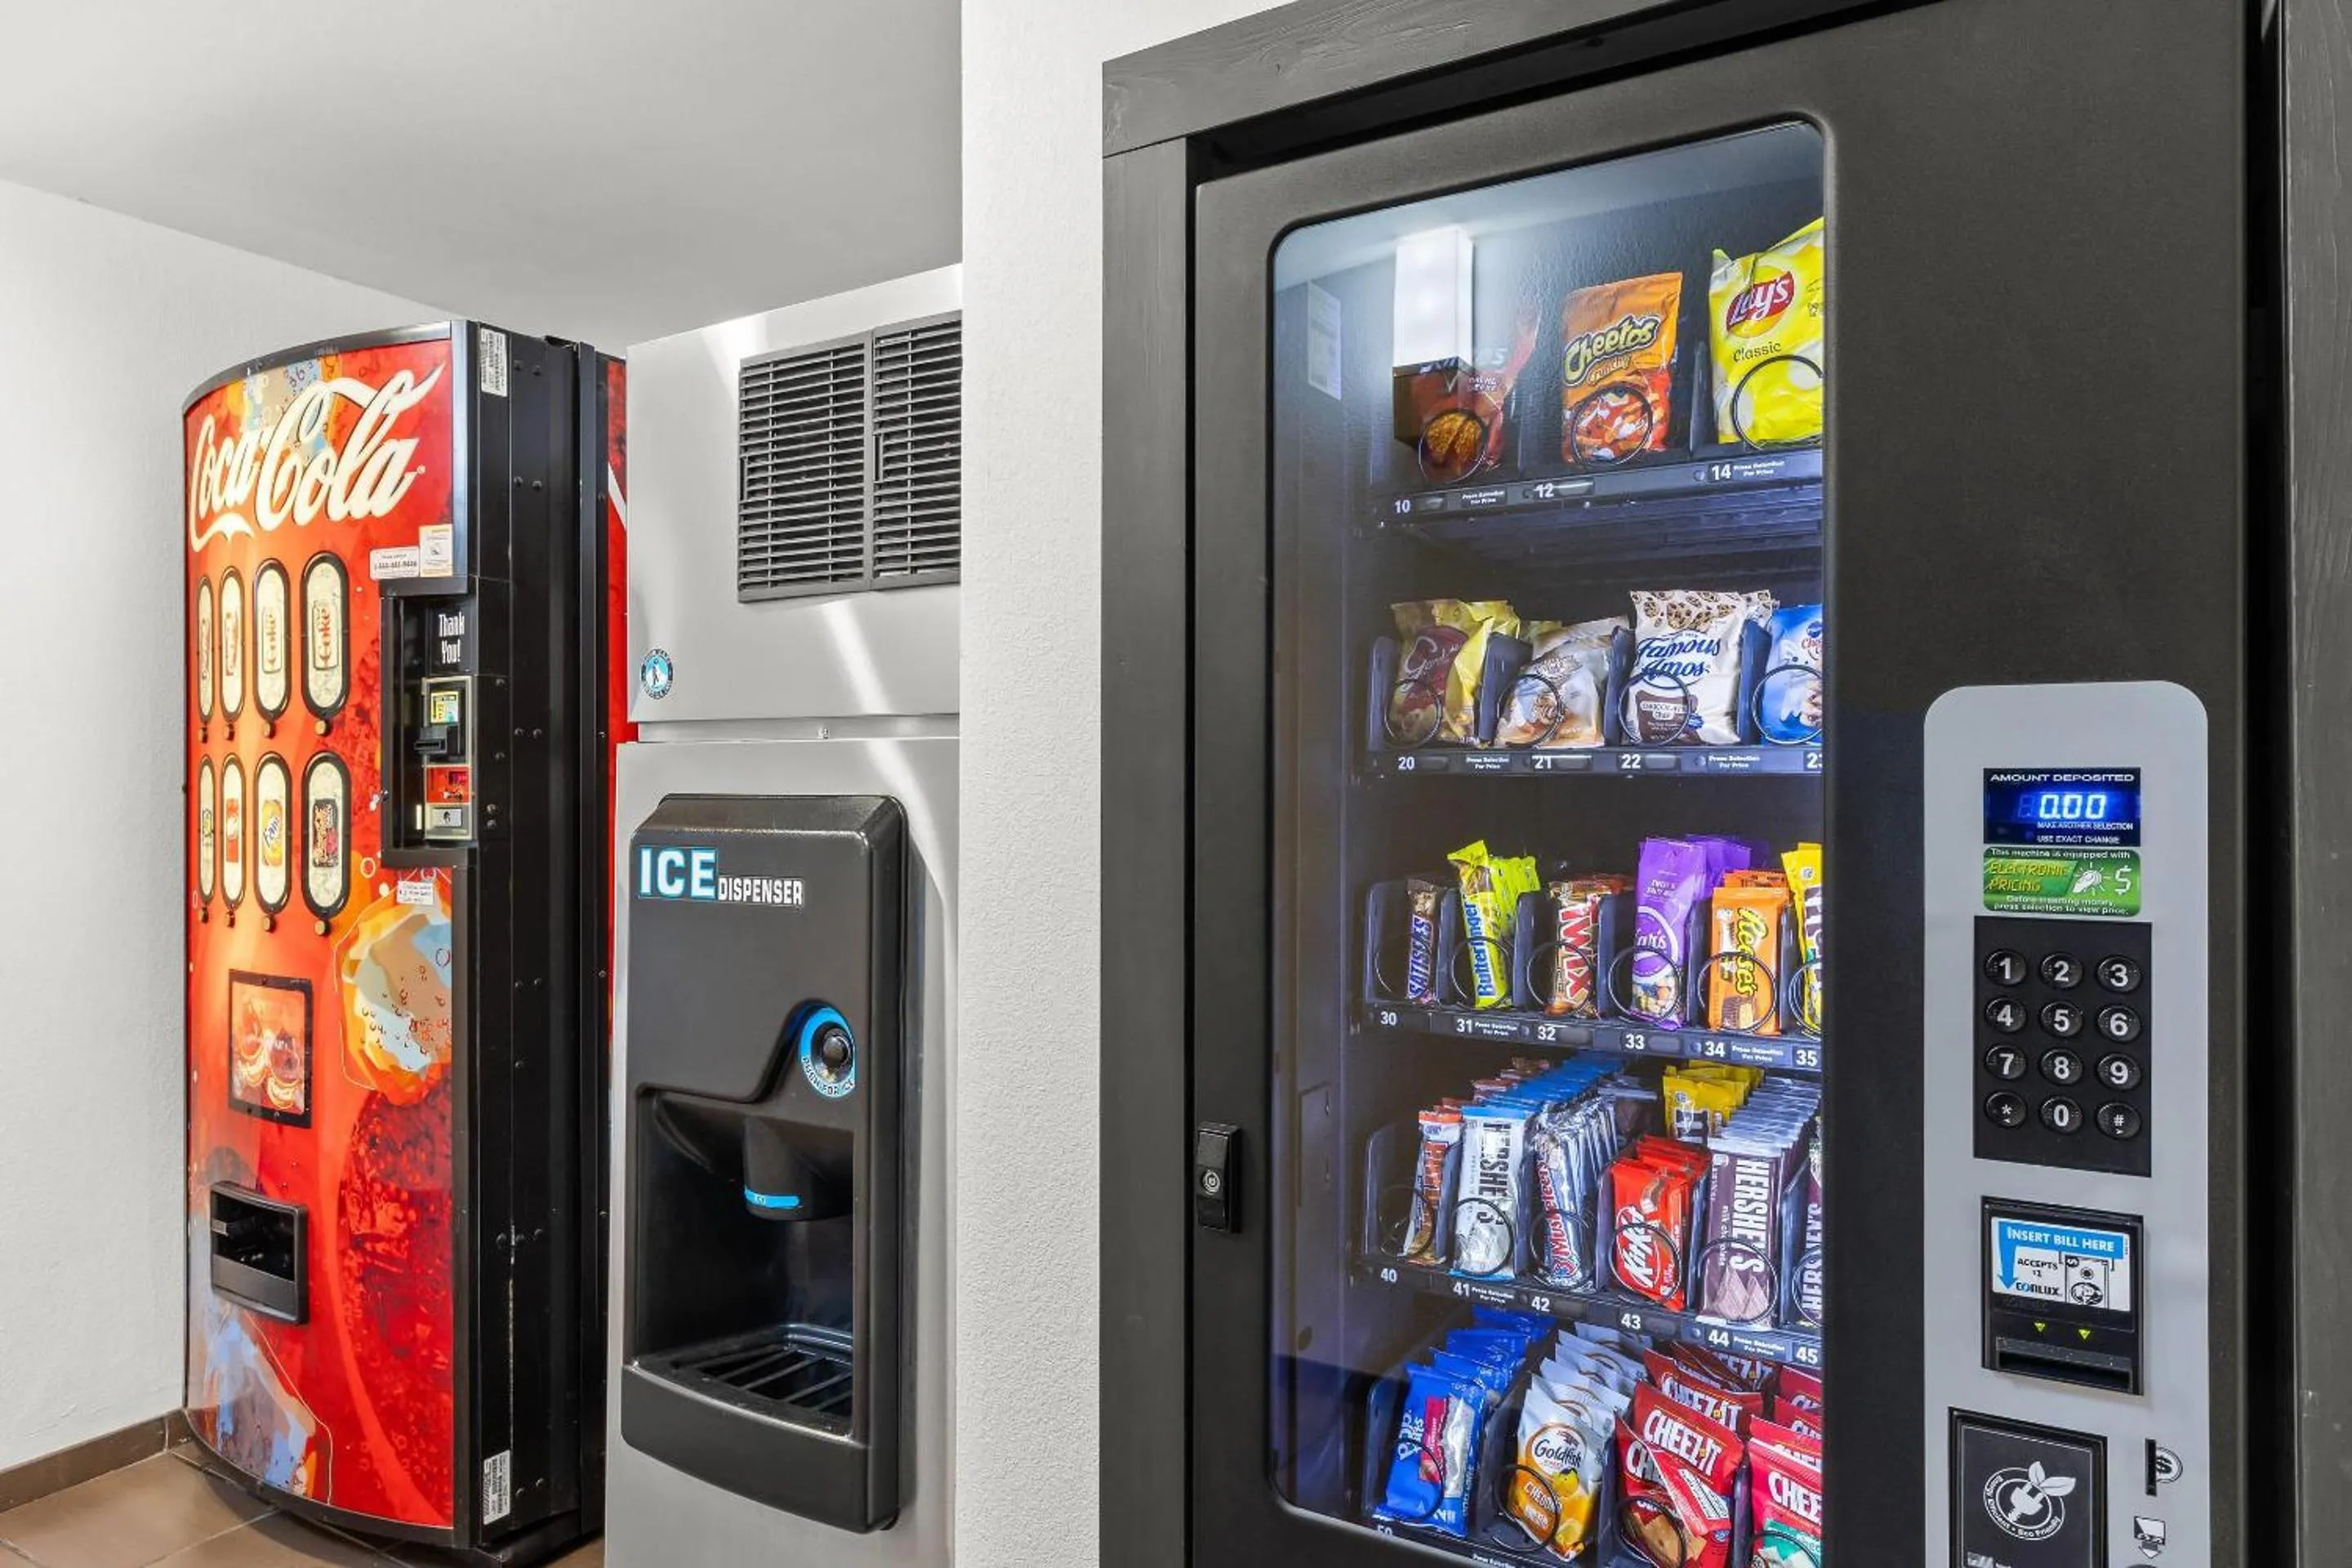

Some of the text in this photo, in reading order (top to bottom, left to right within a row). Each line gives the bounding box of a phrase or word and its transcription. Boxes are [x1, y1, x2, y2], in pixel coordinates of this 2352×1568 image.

[1563, 314, 1661, 386] Cheetos
[1733, 341, 1782, 363] Classic
[1712, 464, 1731, 480] 14
[1395, 500, 1411, 514] 10
[439, 611, 465, 637] Thank
[442, 640, 461, 664] You!
[1638, 637, 1721, 658] Famous
[1398, 756, 1414, 770] 20
[1534, 756, 1552, 769] 21
[1621, 754, 1641, 768] 22
[2063, 851, 2108, 859] equipped
[640, 848, 803, 906] ICE DISPENSER
[1736, 907, 1769, 996] Reese's
[1999, 958, 2011, 979] 1
[2055, 960, 2069, 982] 2
[2110, 964, 2128, 987] 3
[1380, 1012, 1396, 1026] 30
[1997, 1004, 2013, 1027] 4
[2053, 1009, 2070, 1031] 5
[2109, 1013, 2128, 1036] 6
[1456, 1019, 1472, 1033] 31
[1538, 1027, 1556, 1041] 32
[1625, 1035, 1645, 1049] 33
[1704, 1041, 1726, 1058] 34
[1797, 1050, 1818, 1066] 35
[1999, 1054, 2014, 1075] 7
[2053, 1056, 2070, 1080] 8
[2109, 1062, 2128, 1085] 9
[2053, 1104, 2069, 1127] 0
[2007, 1226, 2051, 1244] INSERT
[2053, 1234, 2080, 1248] BILL
[2082, 1239, 2115, 1252] HERE
[2017, 1258, 2058, 1271] ACCEPTS
[1380, 1269, 1397, 1283] 40
[1453, 1282, 1470, 1297] 41
[1531, 1296, 1551, 1312] 42
[1621, 1314, 1641, 1330] 43
[1708, 1330, 1730, 1347] 44
[1797, 1347, 1819, 1364] 45
[1534, 1439, 1582, 1468] Goldfish
